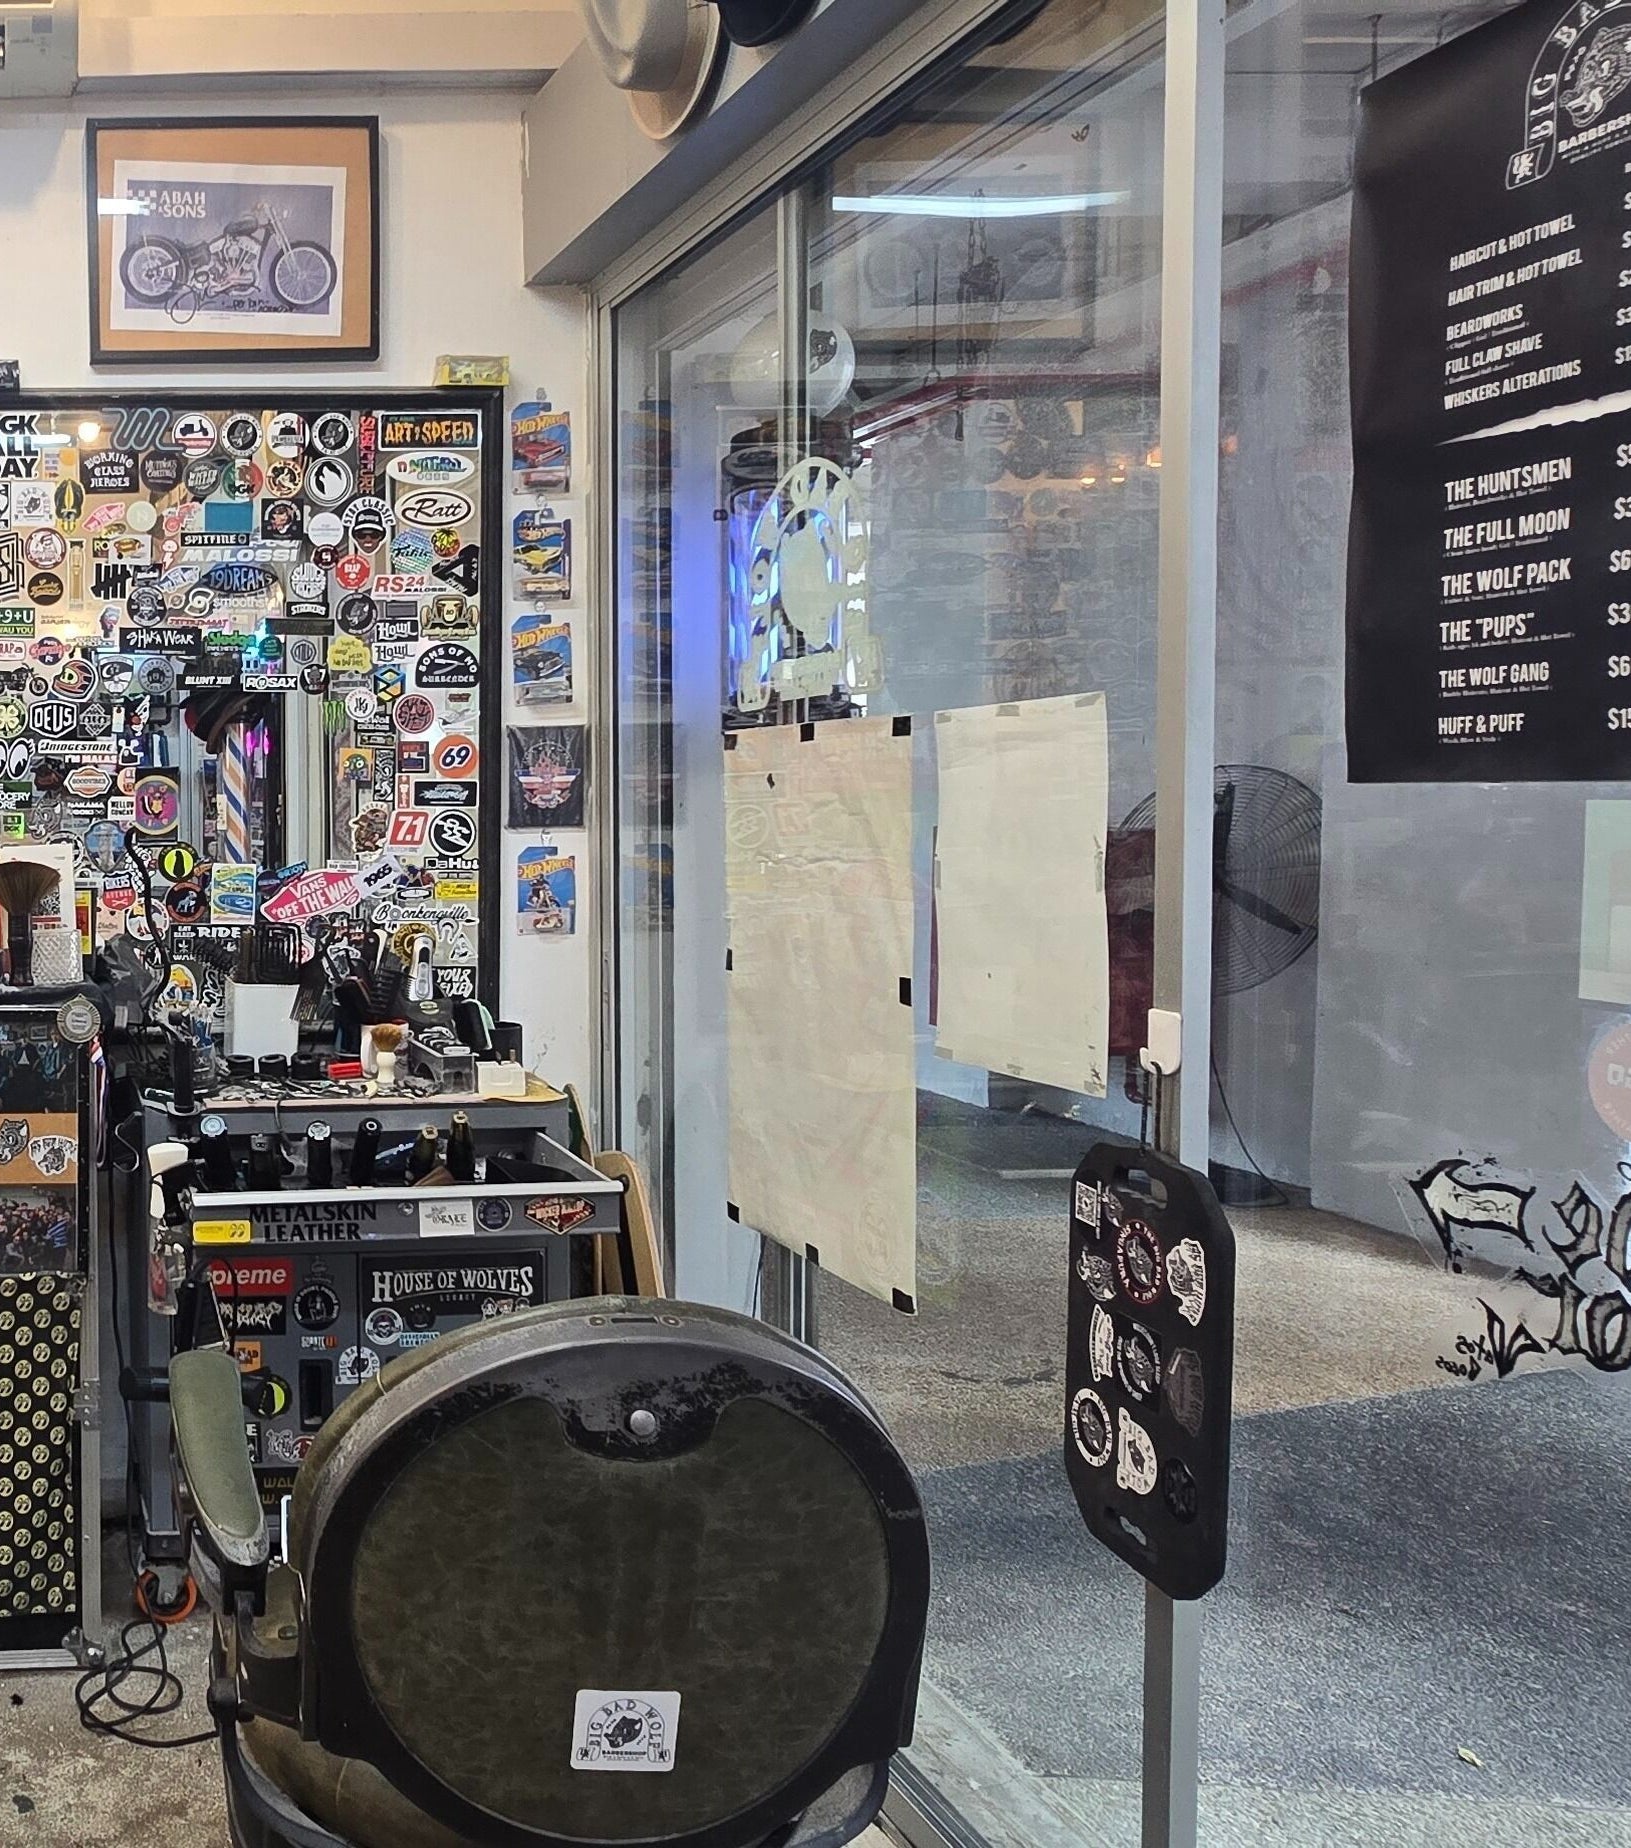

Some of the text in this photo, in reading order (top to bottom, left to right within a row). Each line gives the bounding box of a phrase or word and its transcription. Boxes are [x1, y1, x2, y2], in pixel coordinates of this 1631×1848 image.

[160, 191, 206, 204] ABAH
[164, 205, 206, 218] SONS
[1450, 214, 1576, 271] HAIRCUT & HOT TOWEL
[1448, 248, 1583, 306] HAIR TRIM & HOT TOWEL
[1446, 304, 1524, 341] BEARDWORKS
[1445, 355, 1471, 376] FULL
[1472, 345, 1505, 368] CLAW
[1505, 333, 1543, 358] SHAVE
[1444, 381, 1501, 410] WHISKERS
[1502, 359, 1582, 394] ALTERATIONS
[422, 421, 475, 444] SPEED
[94, 465, 125, 477] CLASS
[1444, 477, 1475, 503] THE
[1477, 457, 1572, 497] HUNTSMEN
[344, 498, 395, 525] STAY CLASSIC
[184, 534, 236, 544] SPITFIRE
[1443, 525, 1474, 550] THE
[1476, 519, 1516, 545] FULL
[1518, 508, 1571, 537] MOON
[182, 549, 298, 562] MALOSSI
[1441, 573, 1473, 597] THE
[1476, 565, 1524, 592] WOLF
[1526, 558, 1572, 585] PACK
[15, 626, 34, 635] YOU
[376, 621, 418, 640] Howl
[1439, 620, 1472, 643] THE
[1475, 612, 1535, 639] "PUPS"
[375, 644, 414, 661] Howl
[448, 646, 464, 656] OF
[1439, 662, 1550, 689] THE WOLF GANG
[33, 703, 72, 732] DEUS
[1438, 713, 1525, 735] HUFF & PUFF
[40, 742, 113, 753] BRIDGESTONE
[441, 746, 470, 767] 69
[397, 816, 424, 842] 7.1
[362, 863, 393, 887] 1965
[289, 876, 328, 900] VANS
[302, 888, 331, 912] THE
[197, 926, 241, 939] RIDE
[249, 1201, 377, 1223] METALSKIN
[264, 1223, 362, 1242] LEATHER
[372, 1266, 534, 1303] HOUSE OF WOLVES
[602, 1699, 637, 1716] BAD
[588, 1706, 662, 1749] BIG WOLF
